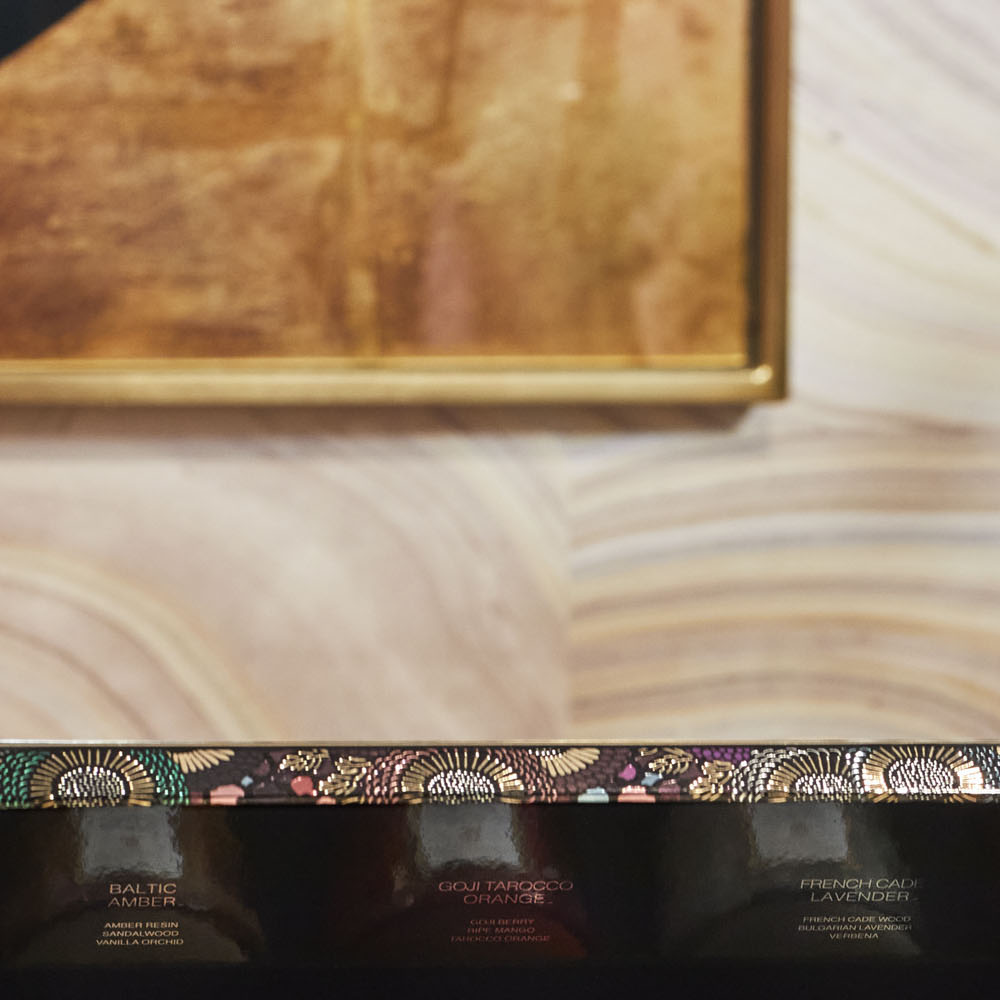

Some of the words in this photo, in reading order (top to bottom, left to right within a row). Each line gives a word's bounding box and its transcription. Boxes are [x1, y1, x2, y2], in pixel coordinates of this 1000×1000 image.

[109, 883, 177, 895] BALTIC
[438, 880, 480, 892] GOJI
[483, 880, 574, 892] TAROCCO
[800, 878, 872, 890] FRENCH
[108, 896, 176, 908] AMBER
[463, 893, 545, 905] ORANGE
[810, 891, 910, 903] LAVENDER
[104, 921, 143, 929] AMBER
[145, 921, 179, 929] RESIN
[803, 916, 846, 924] FRENCH
[141, 938, 184, 946] ORCHID
